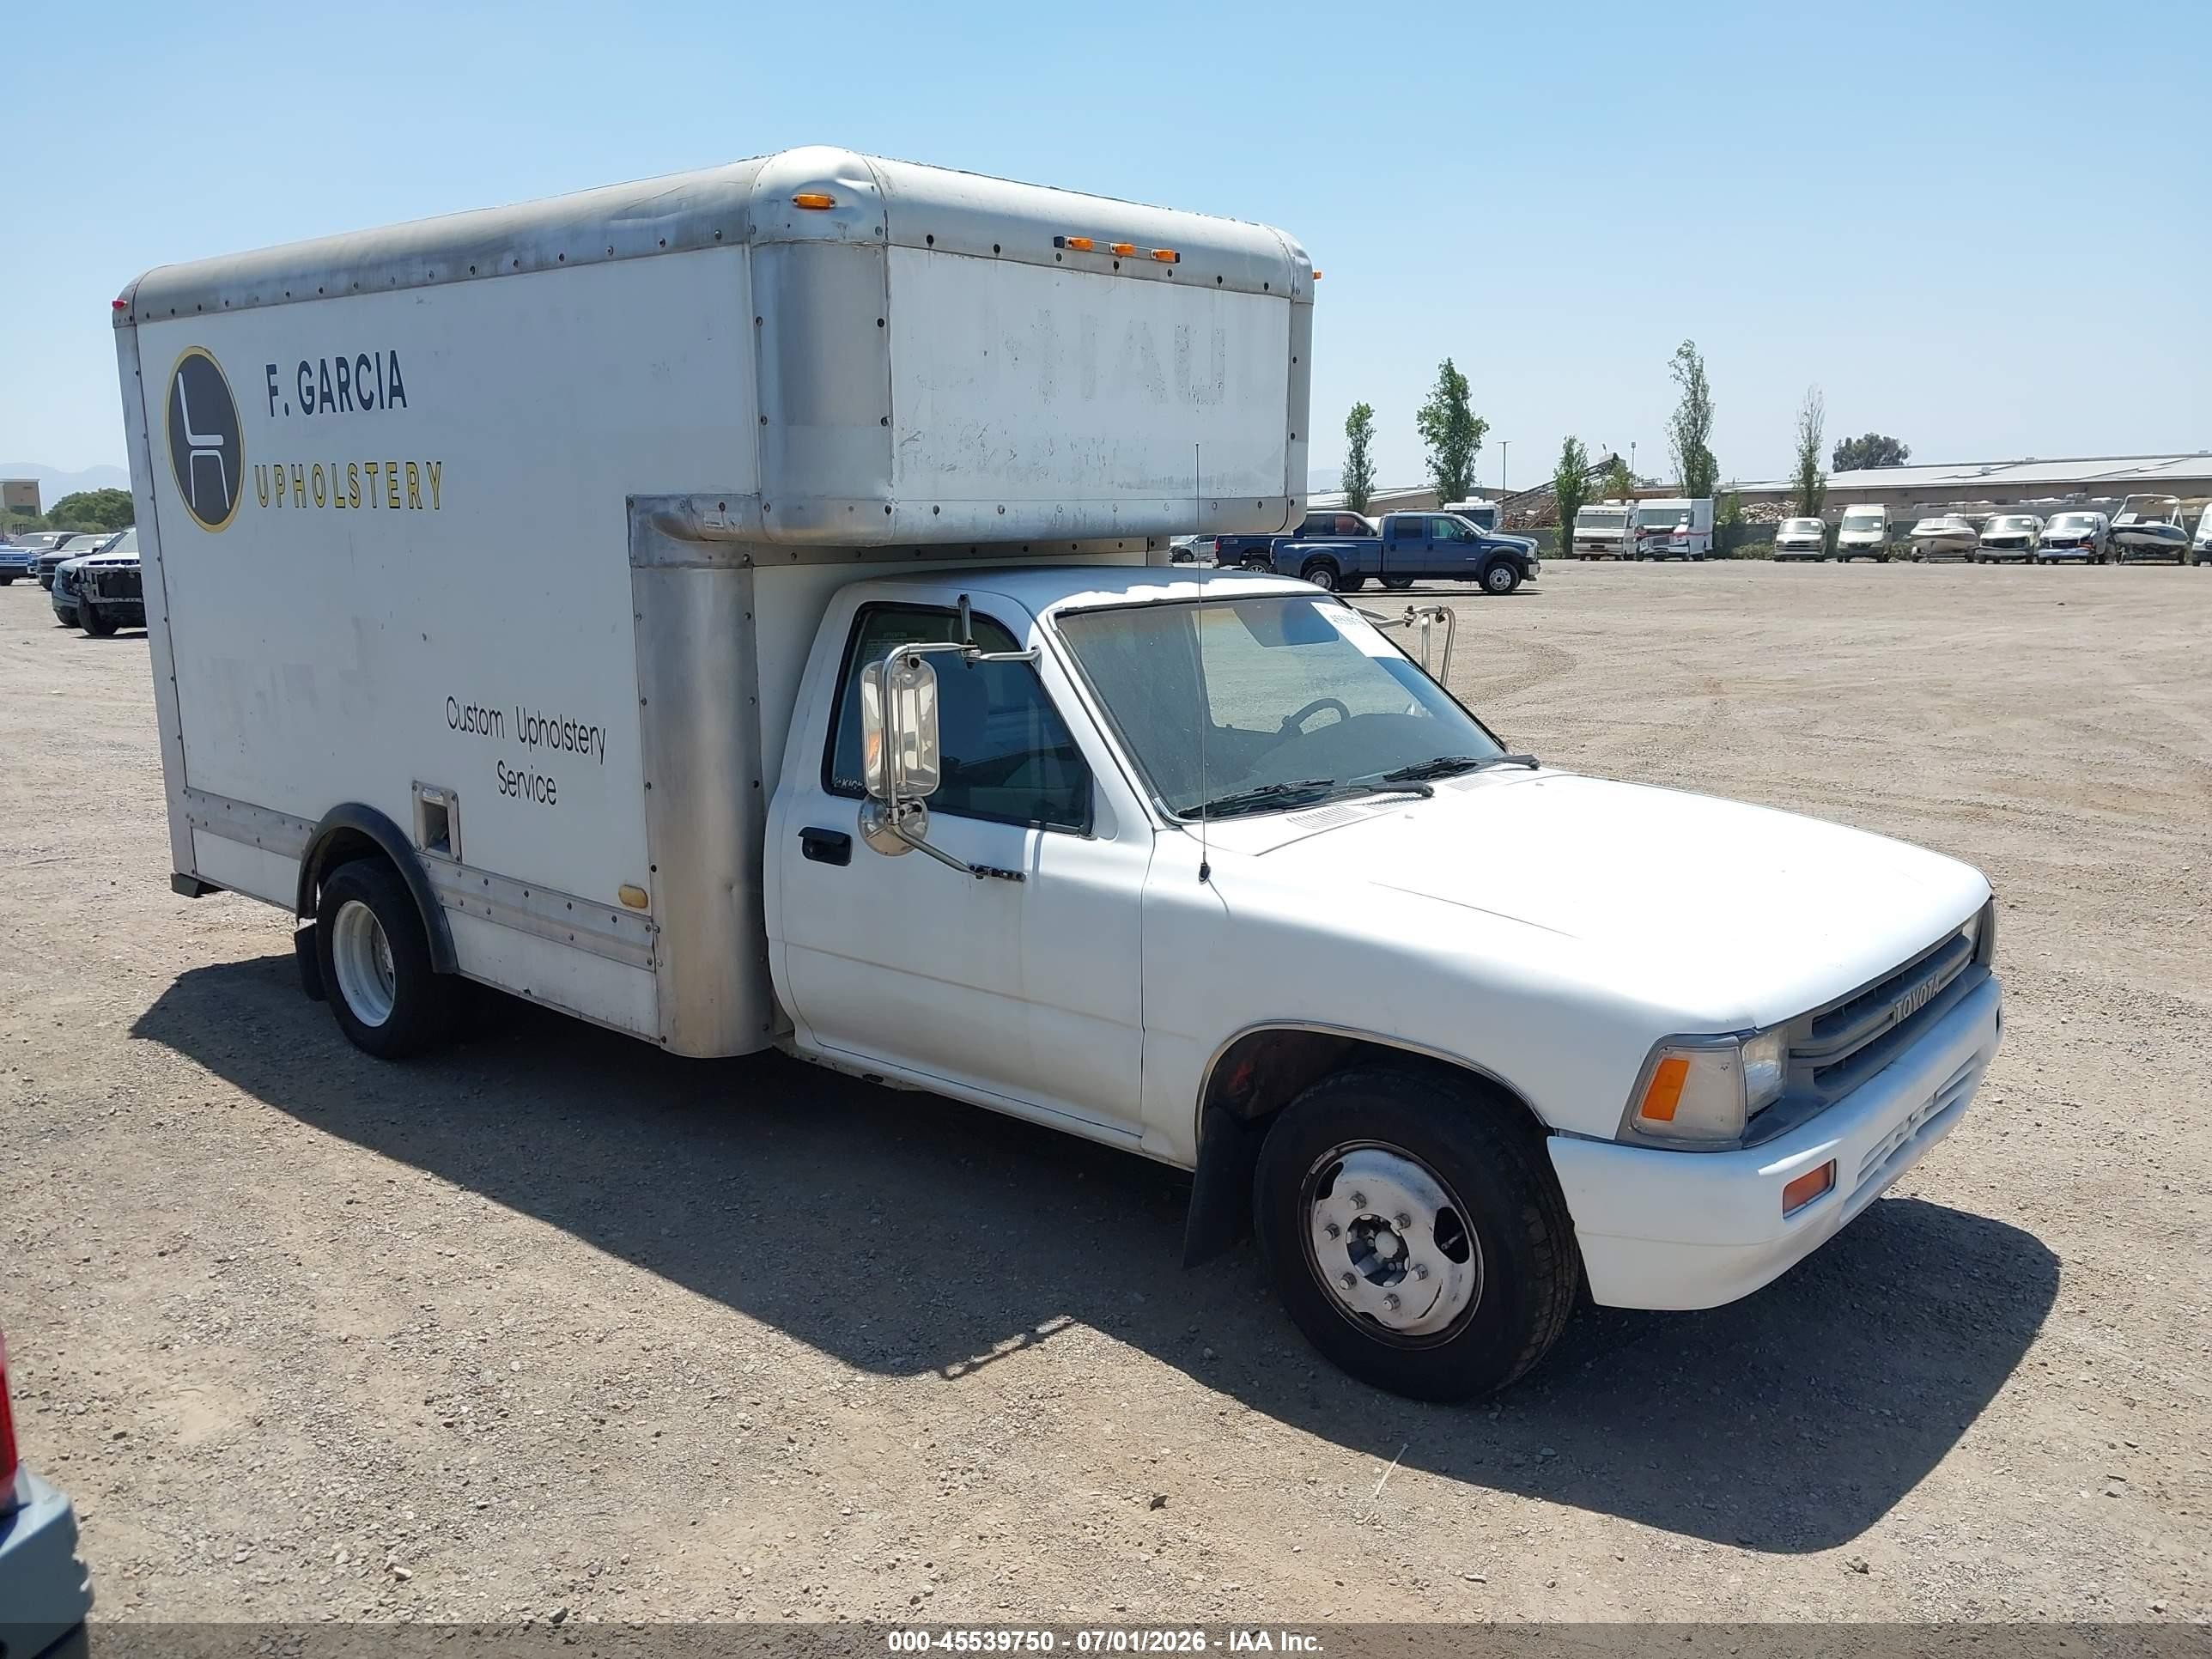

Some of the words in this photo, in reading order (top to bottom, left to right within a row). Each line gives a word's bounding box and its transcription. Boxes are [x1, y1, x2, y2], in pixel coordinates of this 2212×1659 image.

[266, 363, 289, 417] F.
[297, 349, 408, 416] GARCIA
[254, 460, 443, 511] UPHOLSTERY
[446, 696, 505, 739] Custom
[516, 706, 606, 765] Upholstery
[496, 759, 557, 805] Service
[1895, 975, 1940, 1024] TOYOTA
